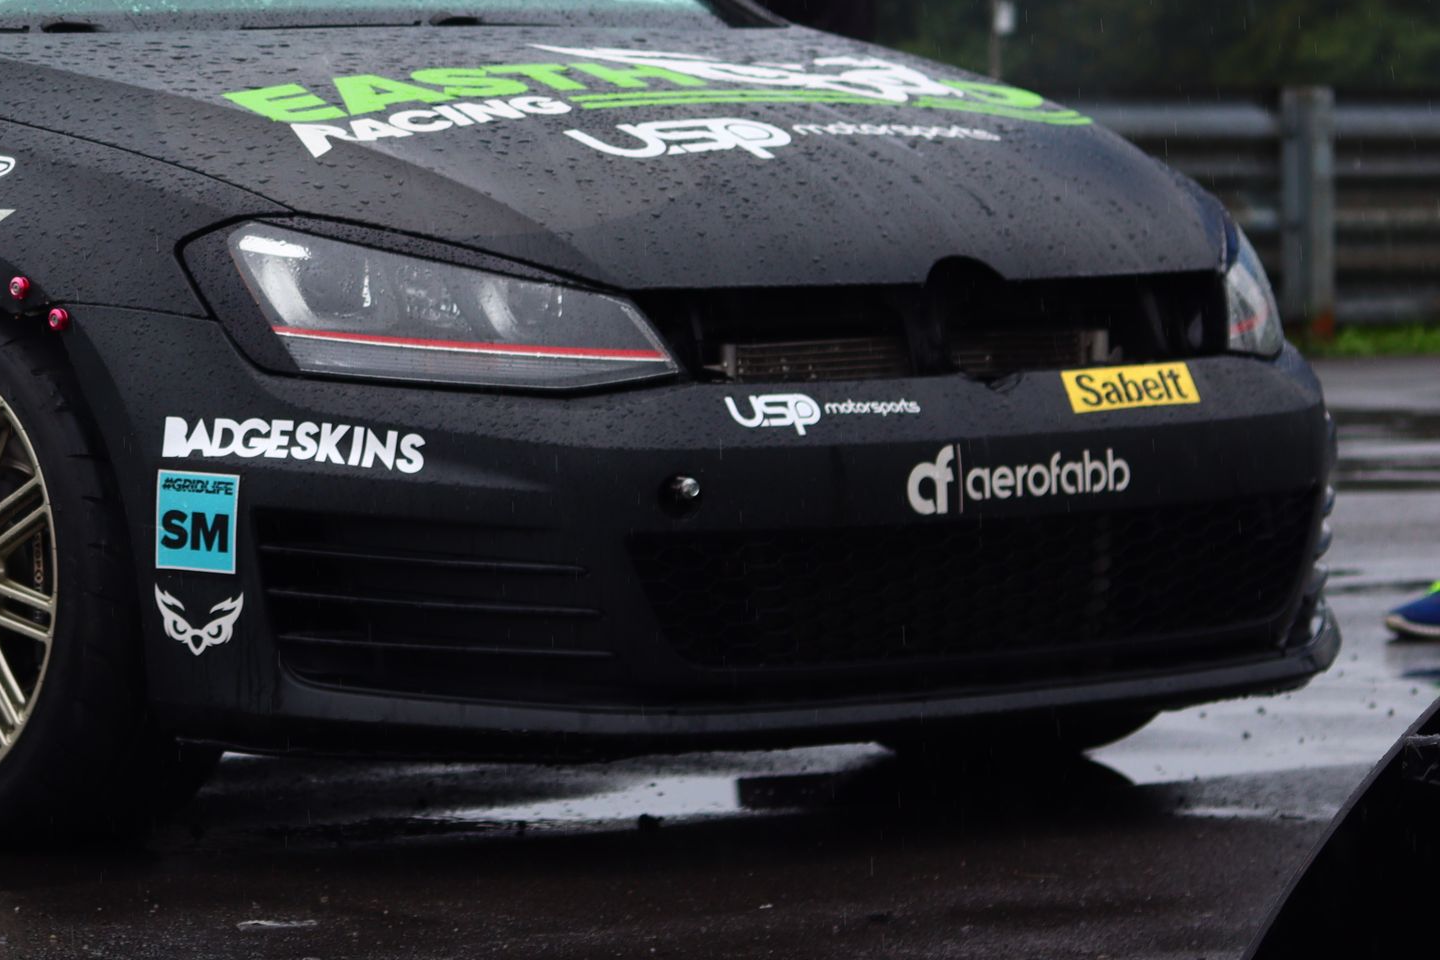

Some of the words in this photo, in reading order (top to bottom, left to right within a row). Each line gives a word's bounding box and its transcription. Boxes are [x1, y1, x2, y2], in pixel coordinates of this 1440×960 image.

[291, 96, 572, 158] RACING
[824, 398, 920, 416] motorsports
[1075, 368, 1189, 407] Sabelt
[162, 416, 426, 474] BADGESKINS
[162, 477, 234, 496] #GRIDLIFE
[965, 447, 1131, 501] aerofabb
[160, 509, 229, 553] SM
